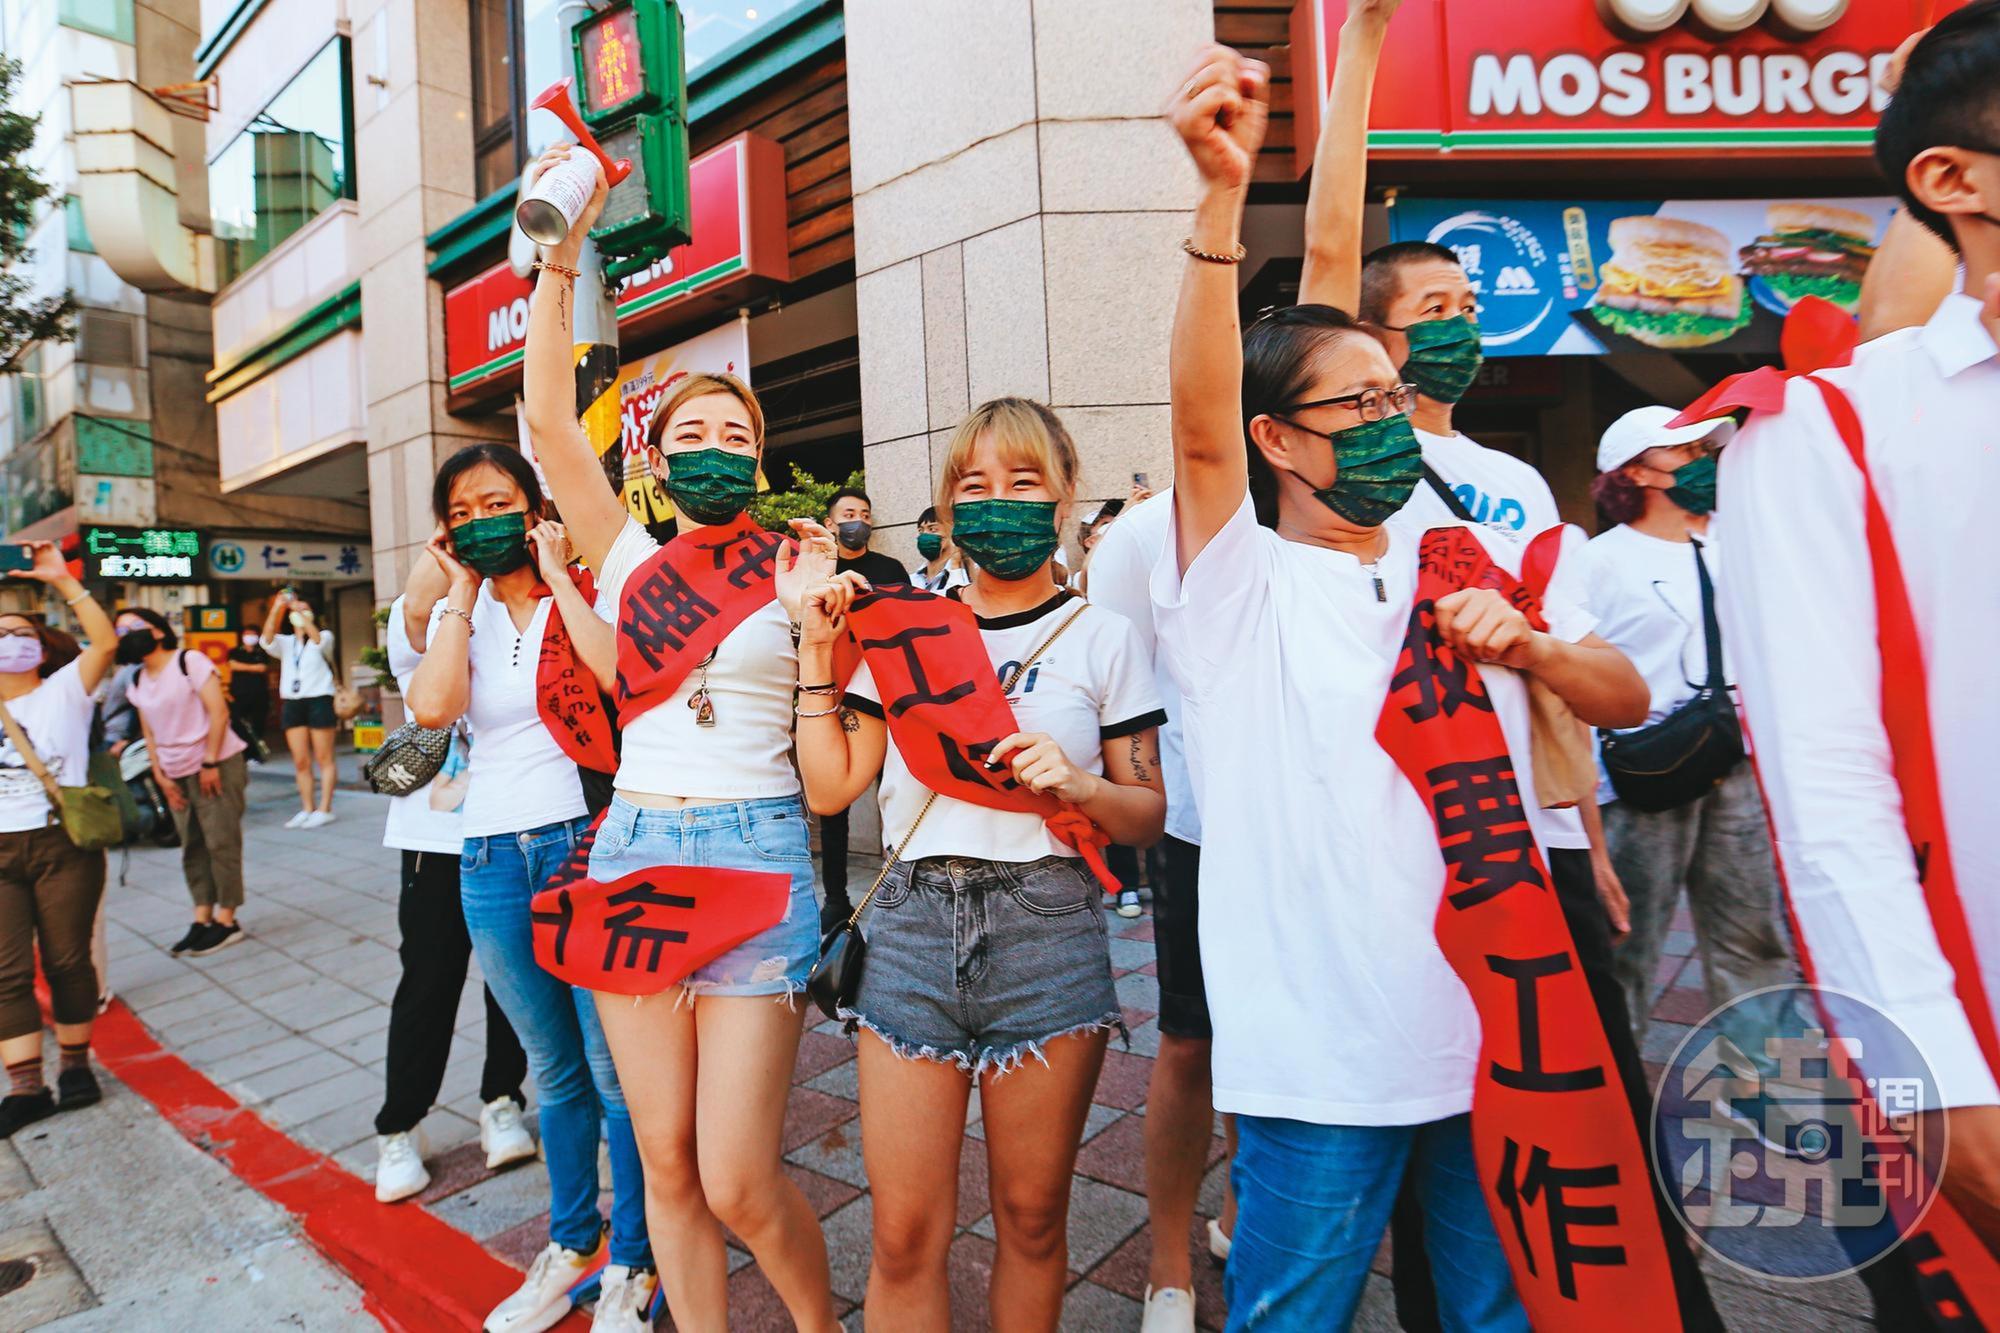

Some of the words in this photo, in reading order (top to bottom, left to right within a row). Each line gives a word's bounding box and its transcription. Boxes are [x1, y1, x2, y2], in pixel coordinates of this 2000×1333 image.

[1468, 51, 1652, 117] MOS
[488, 288, 537, 352] MO
[86, 527, 200, 556] 仁一藥局
